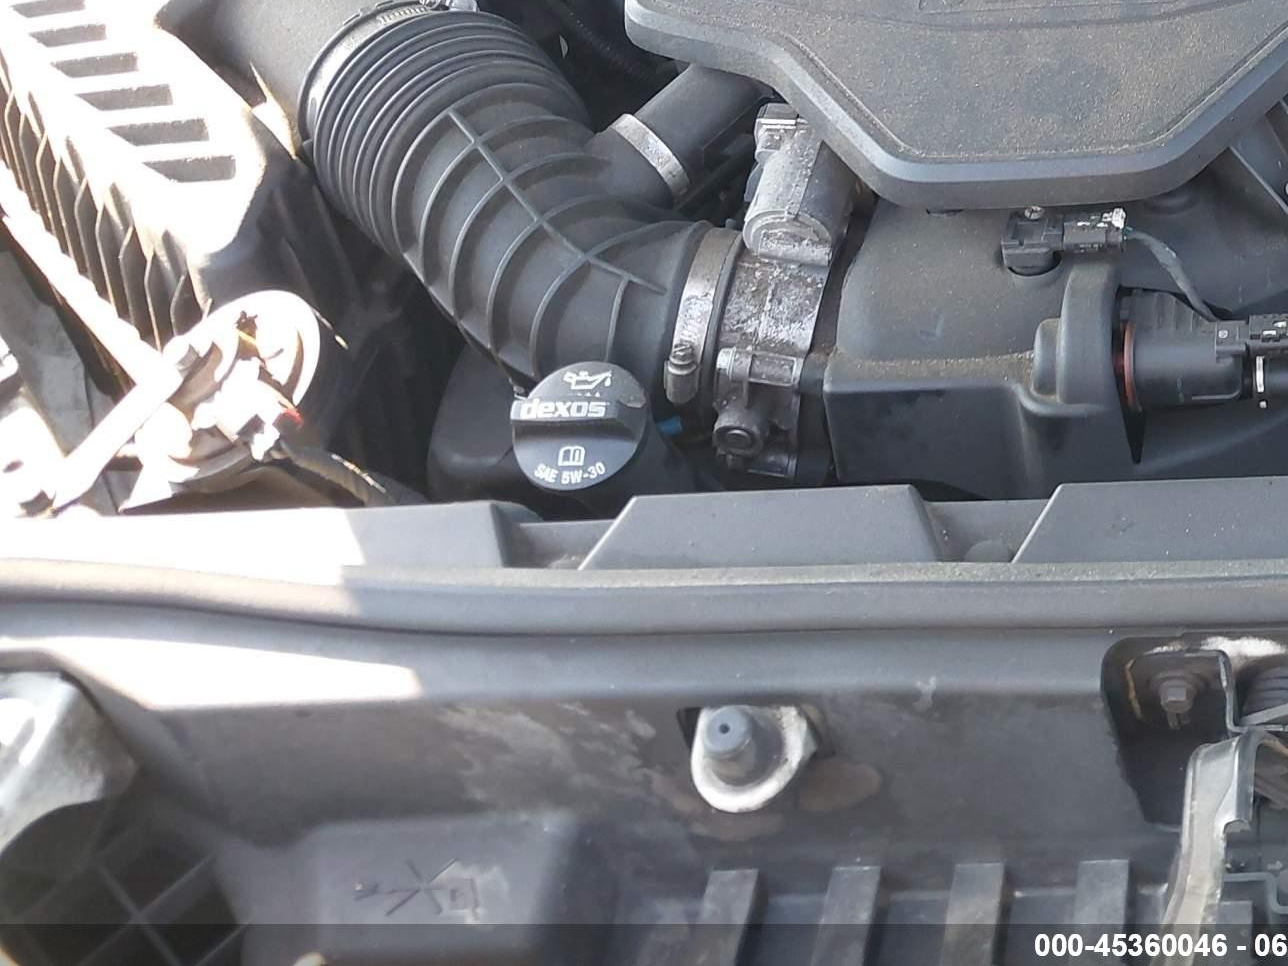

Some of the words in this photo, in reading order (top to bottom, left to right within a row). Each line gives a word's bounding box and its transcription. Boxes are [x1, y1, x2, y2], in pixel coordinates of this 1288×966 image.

[520, 398, 607, 419] dexos
[534, 463, 559, 483] SAE
[561, 462, 606, 484] 5W-30
